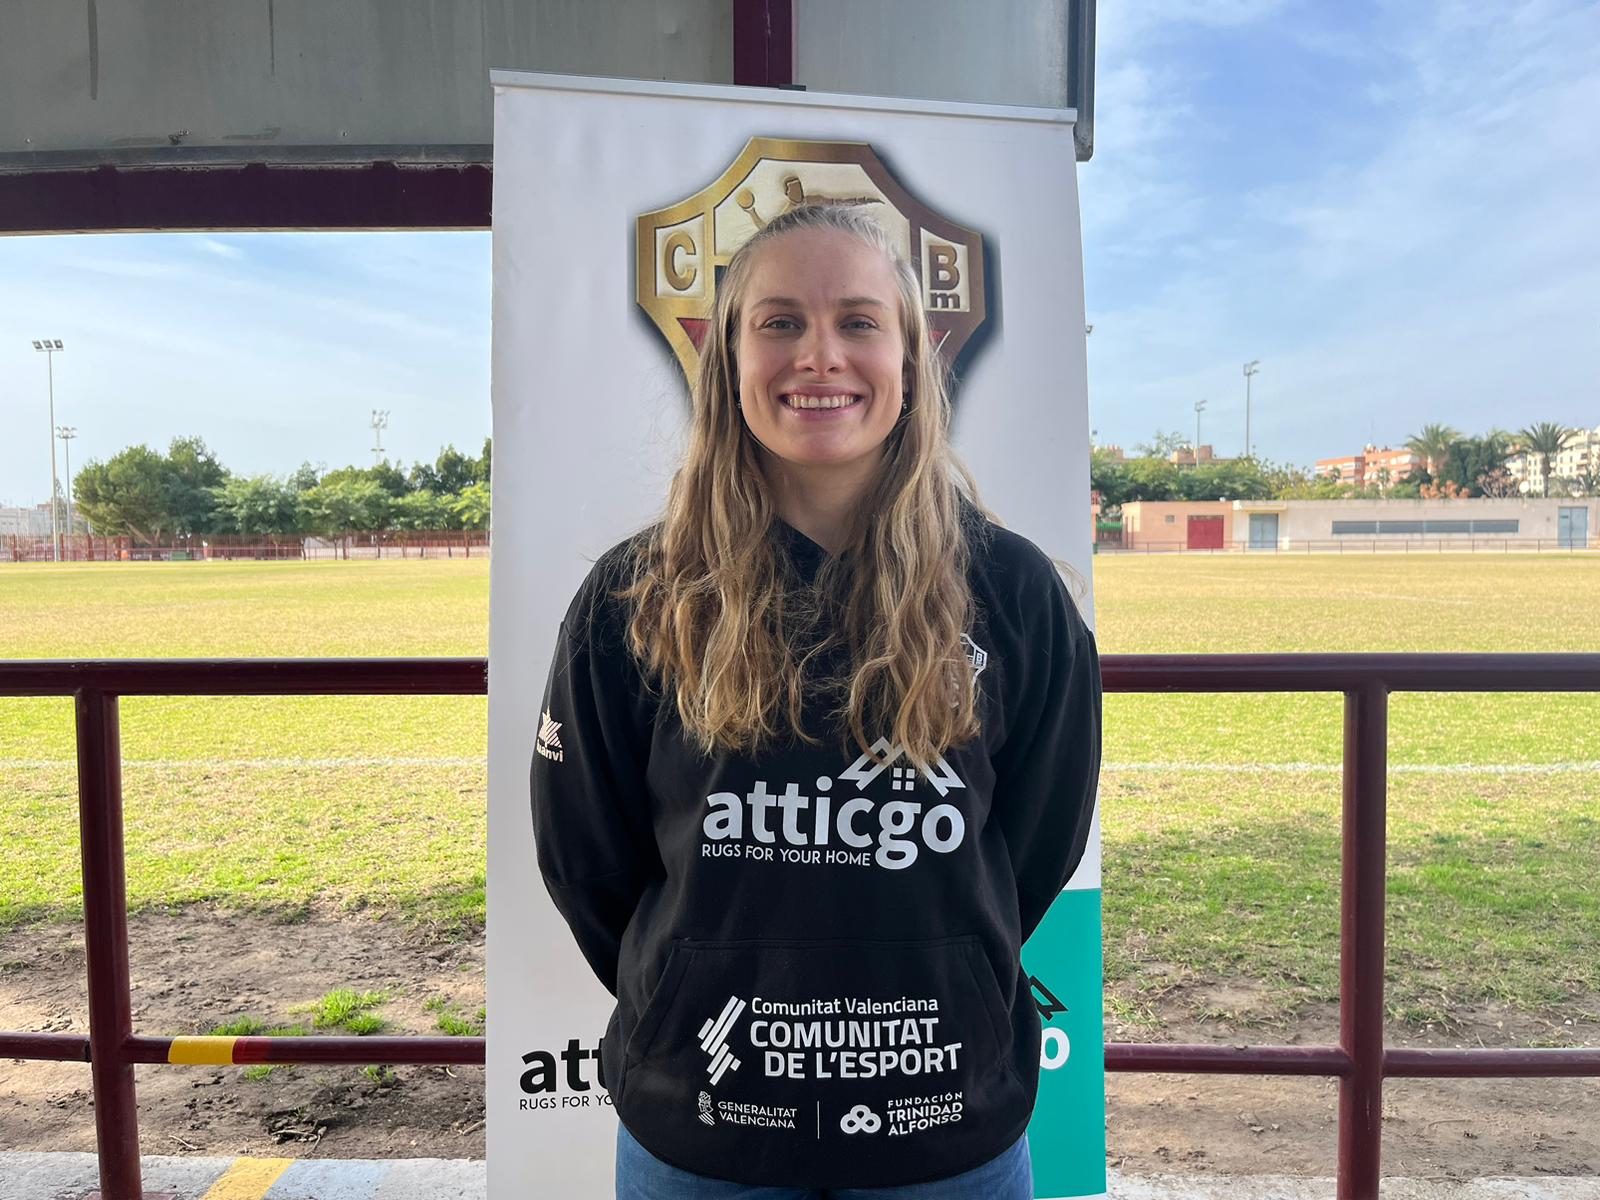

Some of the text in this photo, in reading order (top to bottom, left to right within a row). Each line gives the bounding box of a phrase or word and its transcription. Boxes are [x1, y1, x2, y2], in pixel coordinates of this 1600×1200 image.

[664, 231, 697, 291] C
[702, 775, 966, 870] atticgo
[701, 843, 871, 867] RUGS FOR YOUR HOME
[751, 996, 939, 1016] Comunitat Valenciana
[750, 1017, 940, 1049] COMUNITAT
[764, 1050, 806, 1079] DE
[519, 1097, 557, 1111] RUGS
[562, 1095, 591, 1109] FOR
[717, 1100, 798, 1118] GENERALITAT
[887, 1091, 963, 1109] FUNDACIÓN
[719, 1110, 796, 1129] VALENCIANA
[886, 1101, 963, 1124] TRINIDAD
[887, 1113, 962, 1136] ALFONSO
